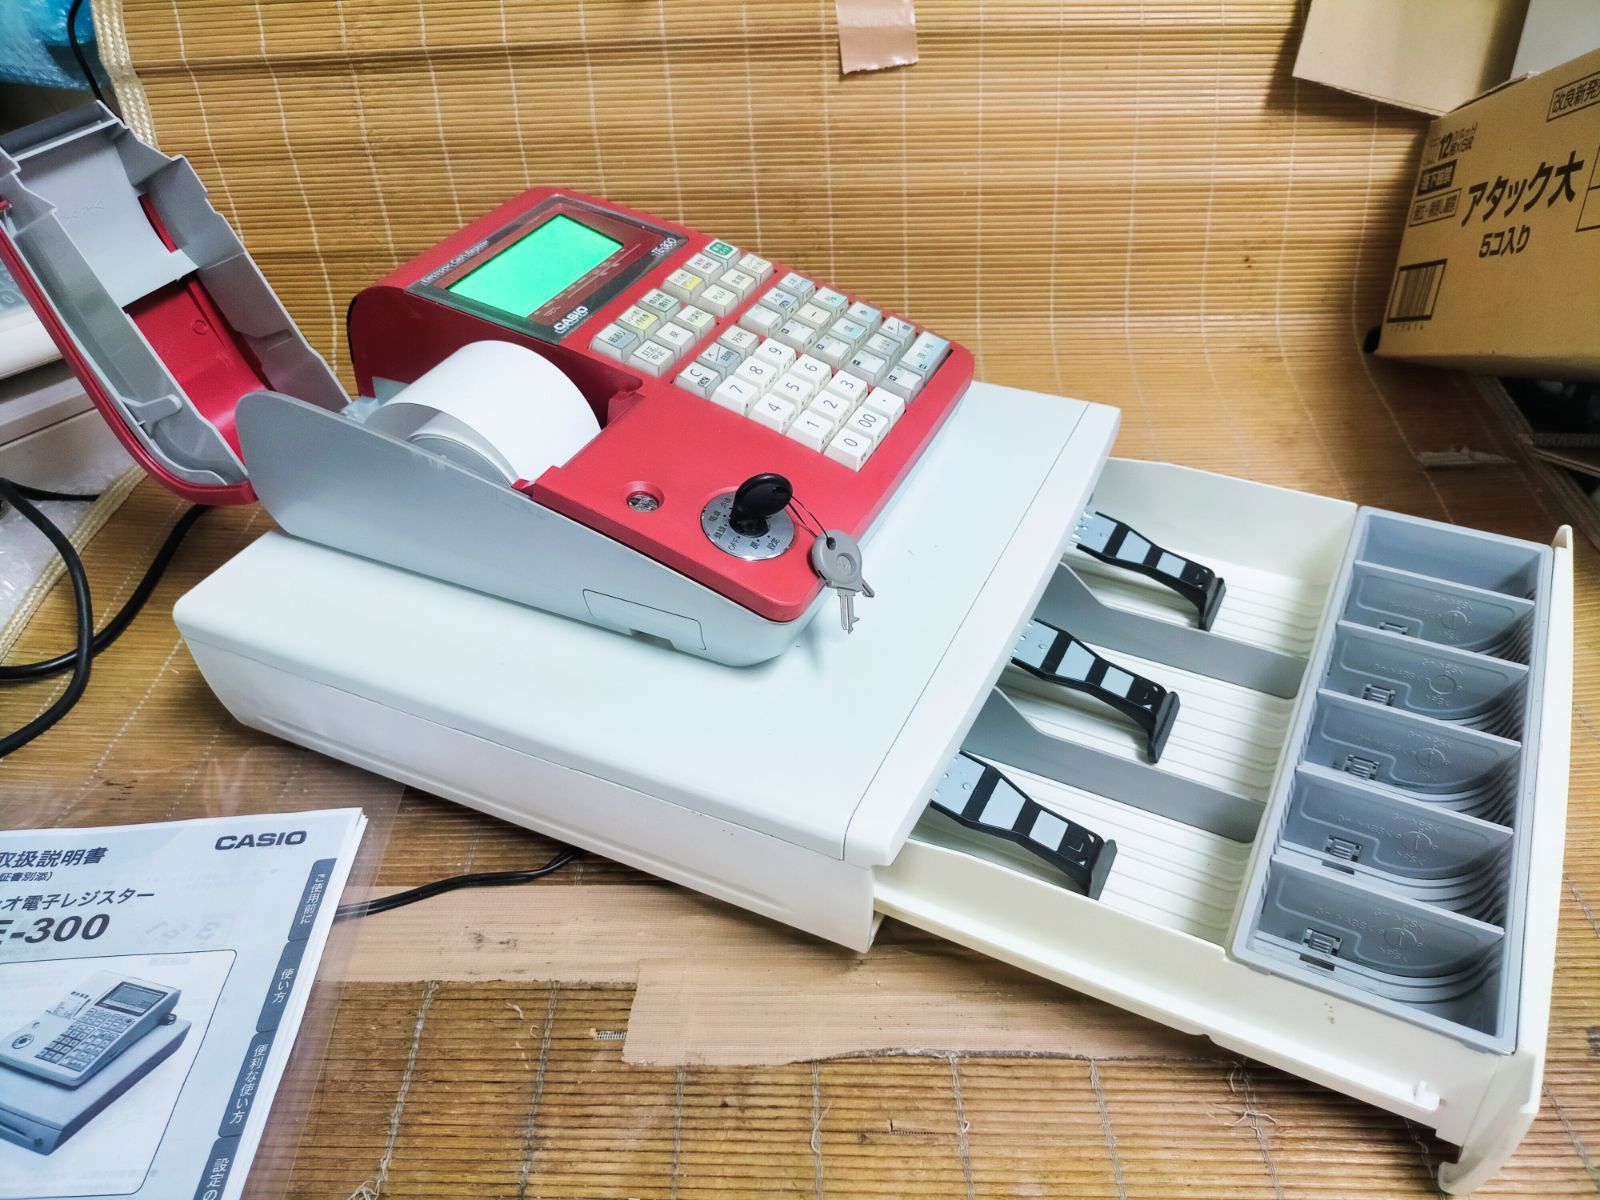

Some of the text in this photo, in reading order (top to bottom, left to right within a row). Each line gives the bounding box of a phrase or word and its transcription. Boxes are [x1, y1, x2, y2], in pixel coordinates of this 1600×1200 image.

[1462, 151, 1584, 227] アタック大
[1478, 224, 1531, 258] 5コ入り
[554, 305, 589, 331] CASIO
[768, 346, 782, 356] 9
[749, 365, 764, 375] 8
[804, 362, 818, 372] 6
[729, 384, 744, 394] 7
[785, 382, 799, 392] 5
[840, 380, 854, 389] 3
[768, 402, 782, 412] 4
[823, 399, 838, 409] 2
[806, 420, 819, 428] 1
[858, 413, 877, 428] 00
[843, 438, 858, 447] 0
[728, 538, 740, 551] OFF
[214, 830, 307, 850] CASIO
[0, 847, 108, 869] 取扱説明書
[300, 873, 326, 925] ご使用前に
[272, 968, 295, 1004] 使い方
[229, 1043, 269, 1125] 便利な使い方
[203, 1157, 230, 1200] 設定の
